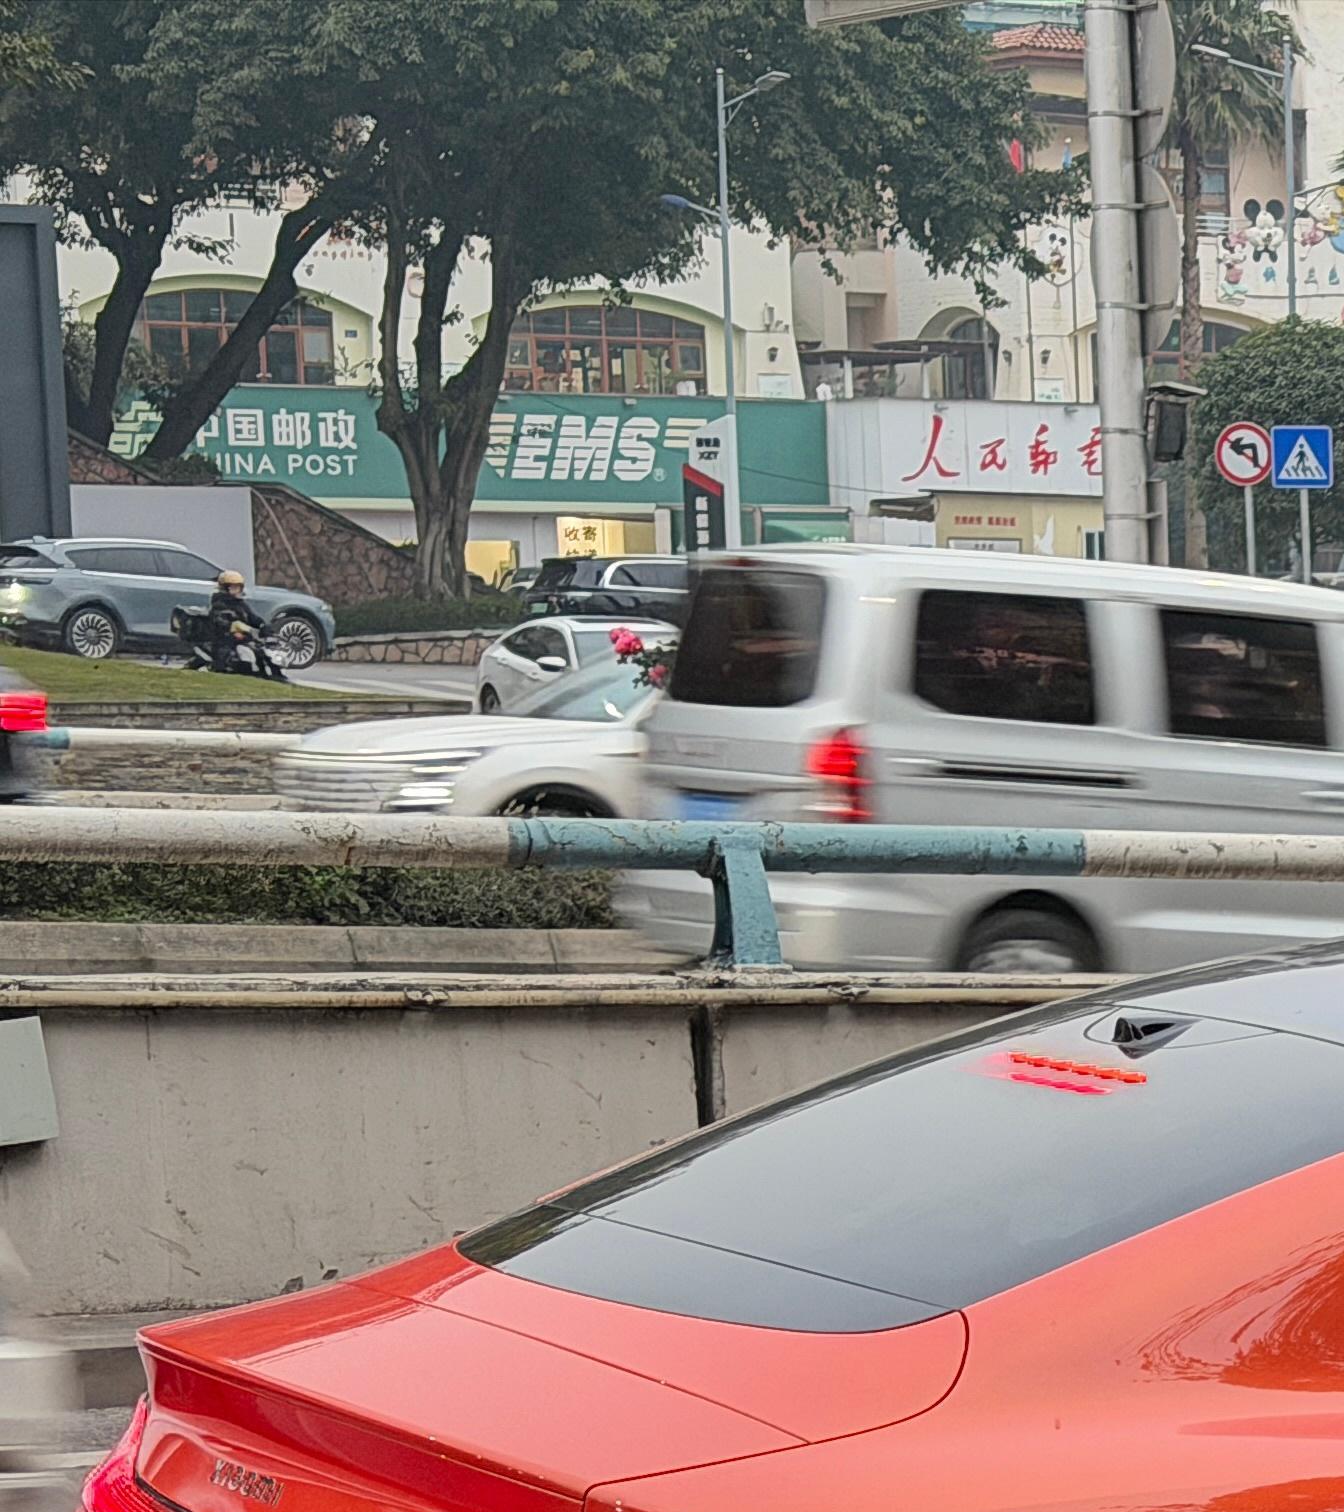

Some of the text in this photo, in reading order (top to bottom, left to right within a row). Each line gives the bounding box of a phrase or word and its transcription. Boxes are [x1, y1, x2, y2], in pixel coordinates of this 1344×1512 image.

[184, 452, 358, 476] HINA POST
[511, 414, 661, 481] EMS
